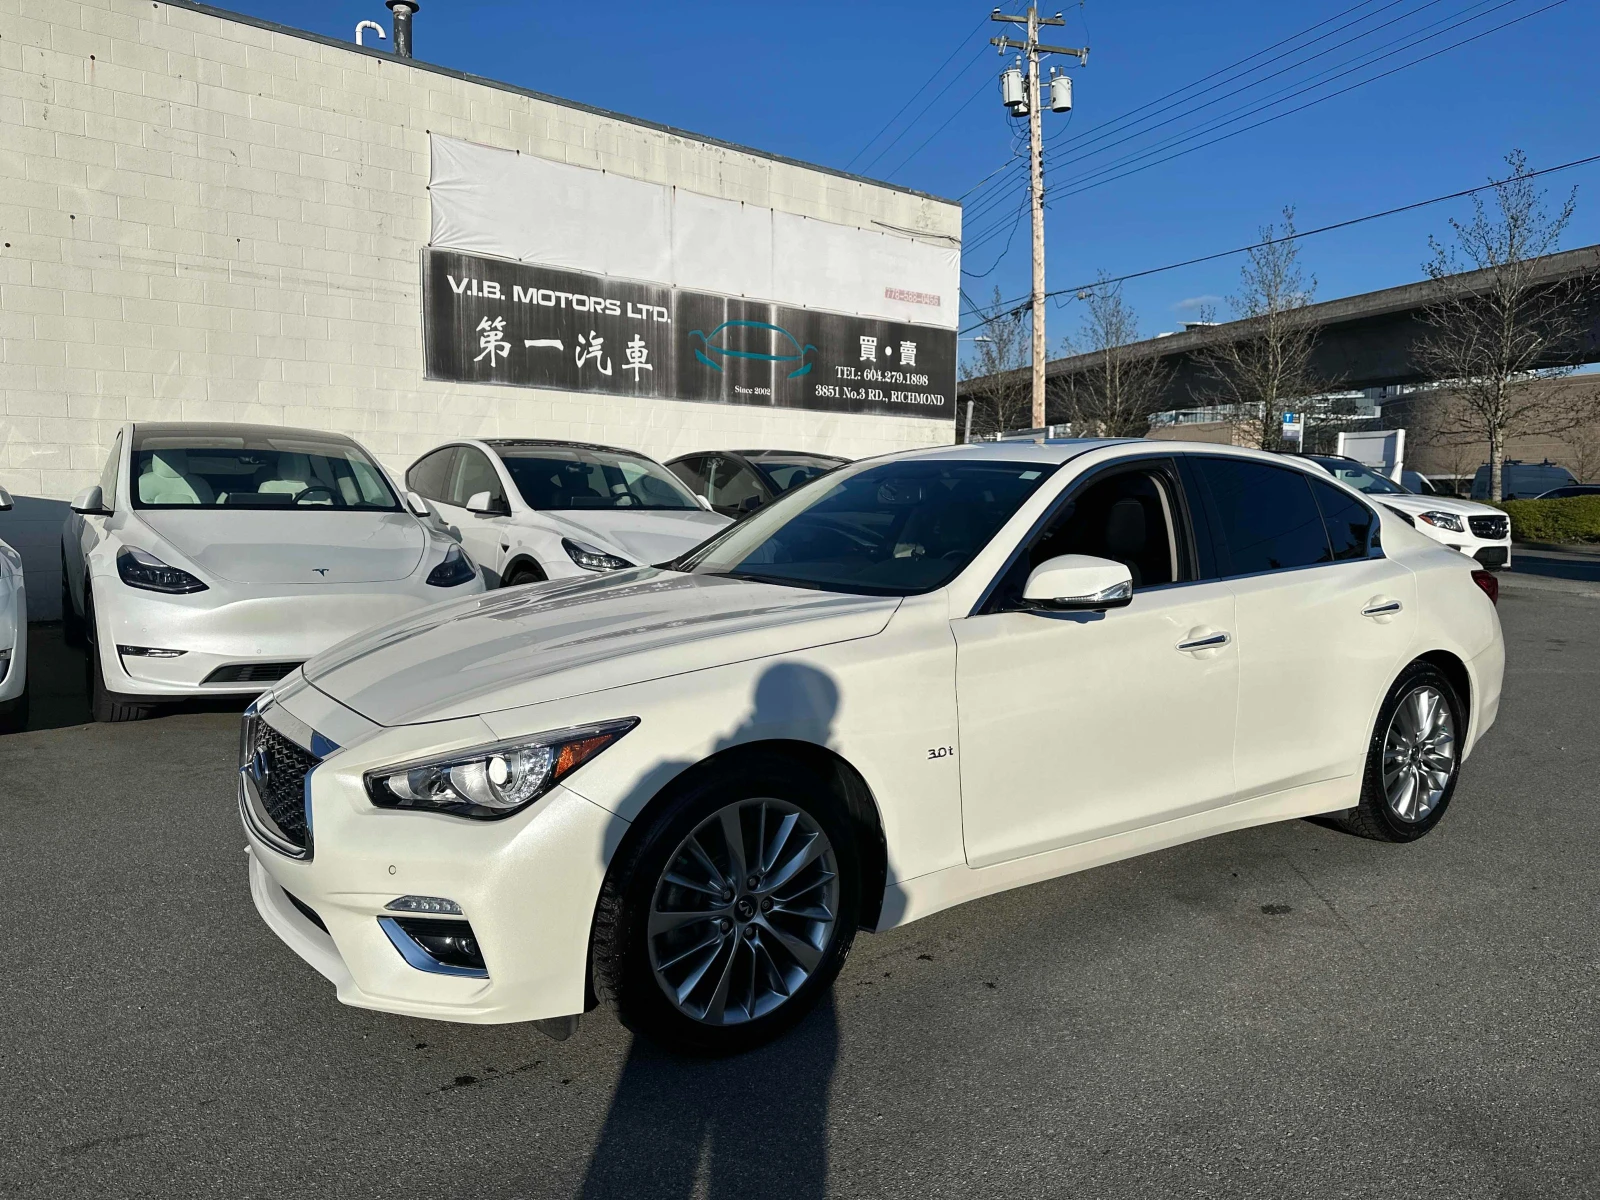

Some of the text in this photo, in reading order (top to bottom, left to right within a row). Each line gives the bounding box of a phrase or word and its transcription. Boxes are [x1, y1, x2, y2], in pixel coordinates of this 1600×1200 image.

[446, 275, 671, 323] V.I.B. MOTORS LTD.
[473, 315, 653, 382] 第一汽車
[835, 366, 929, 386] TEL: 604.279.1898
[734, 384, 771, 396] Since 2002
[815, 384, 945, 406] 3851 No.3 RD., RICHMOND
